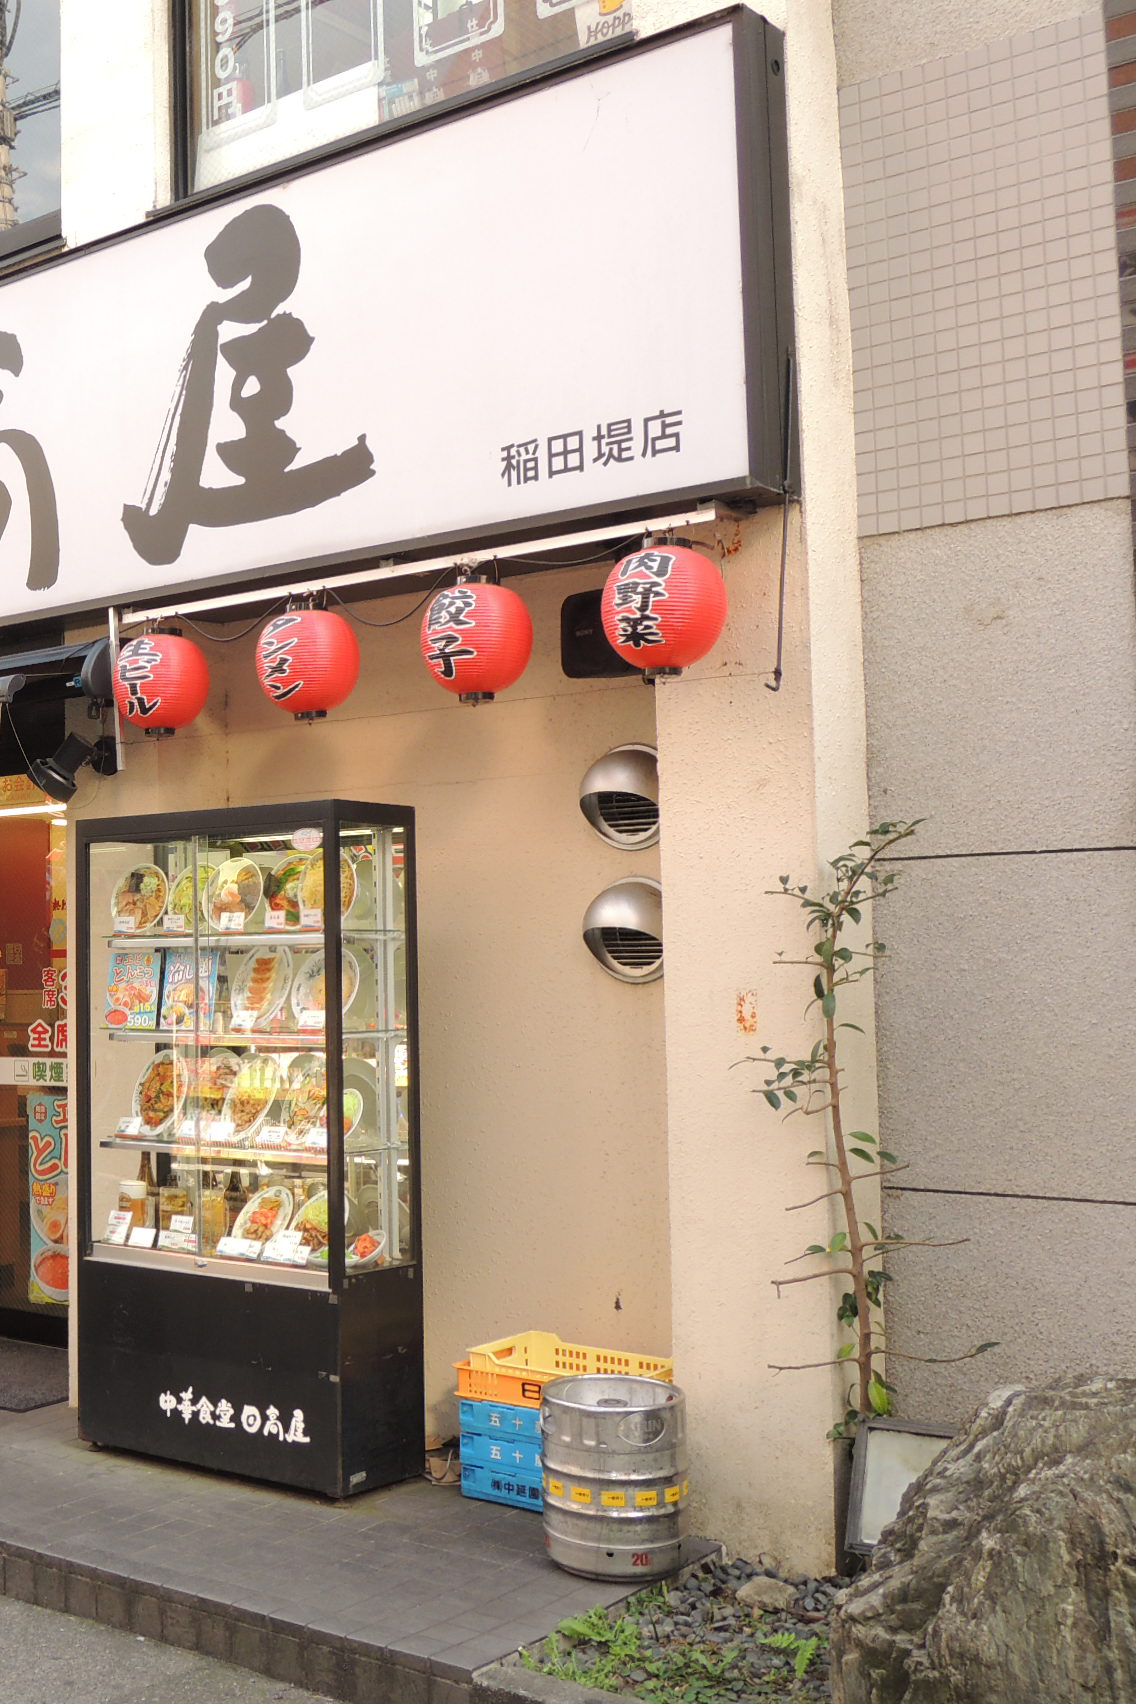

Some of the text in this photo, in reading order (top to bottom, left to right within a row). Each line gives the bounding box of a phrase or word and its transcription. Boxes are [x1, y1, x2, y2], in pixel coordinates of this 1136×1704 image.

[214, 0, 238, 120] 90円
[501, 409, 683, 487] 稲田堤店
[426, 589, 476, 679] 餃子
[614, 551, 675, 648] 肉野菜
[118, 638, 162, 717] 生ビール
[262, 616, 303, 701] タンメン
[41, 967, 57, 1009] 客席
[32, 1060, 68, 1083] 喫煙
[159, 1385, 311, 1443] 中華食堂 日高屋
[489, 1413, 542, 1434] 五十
